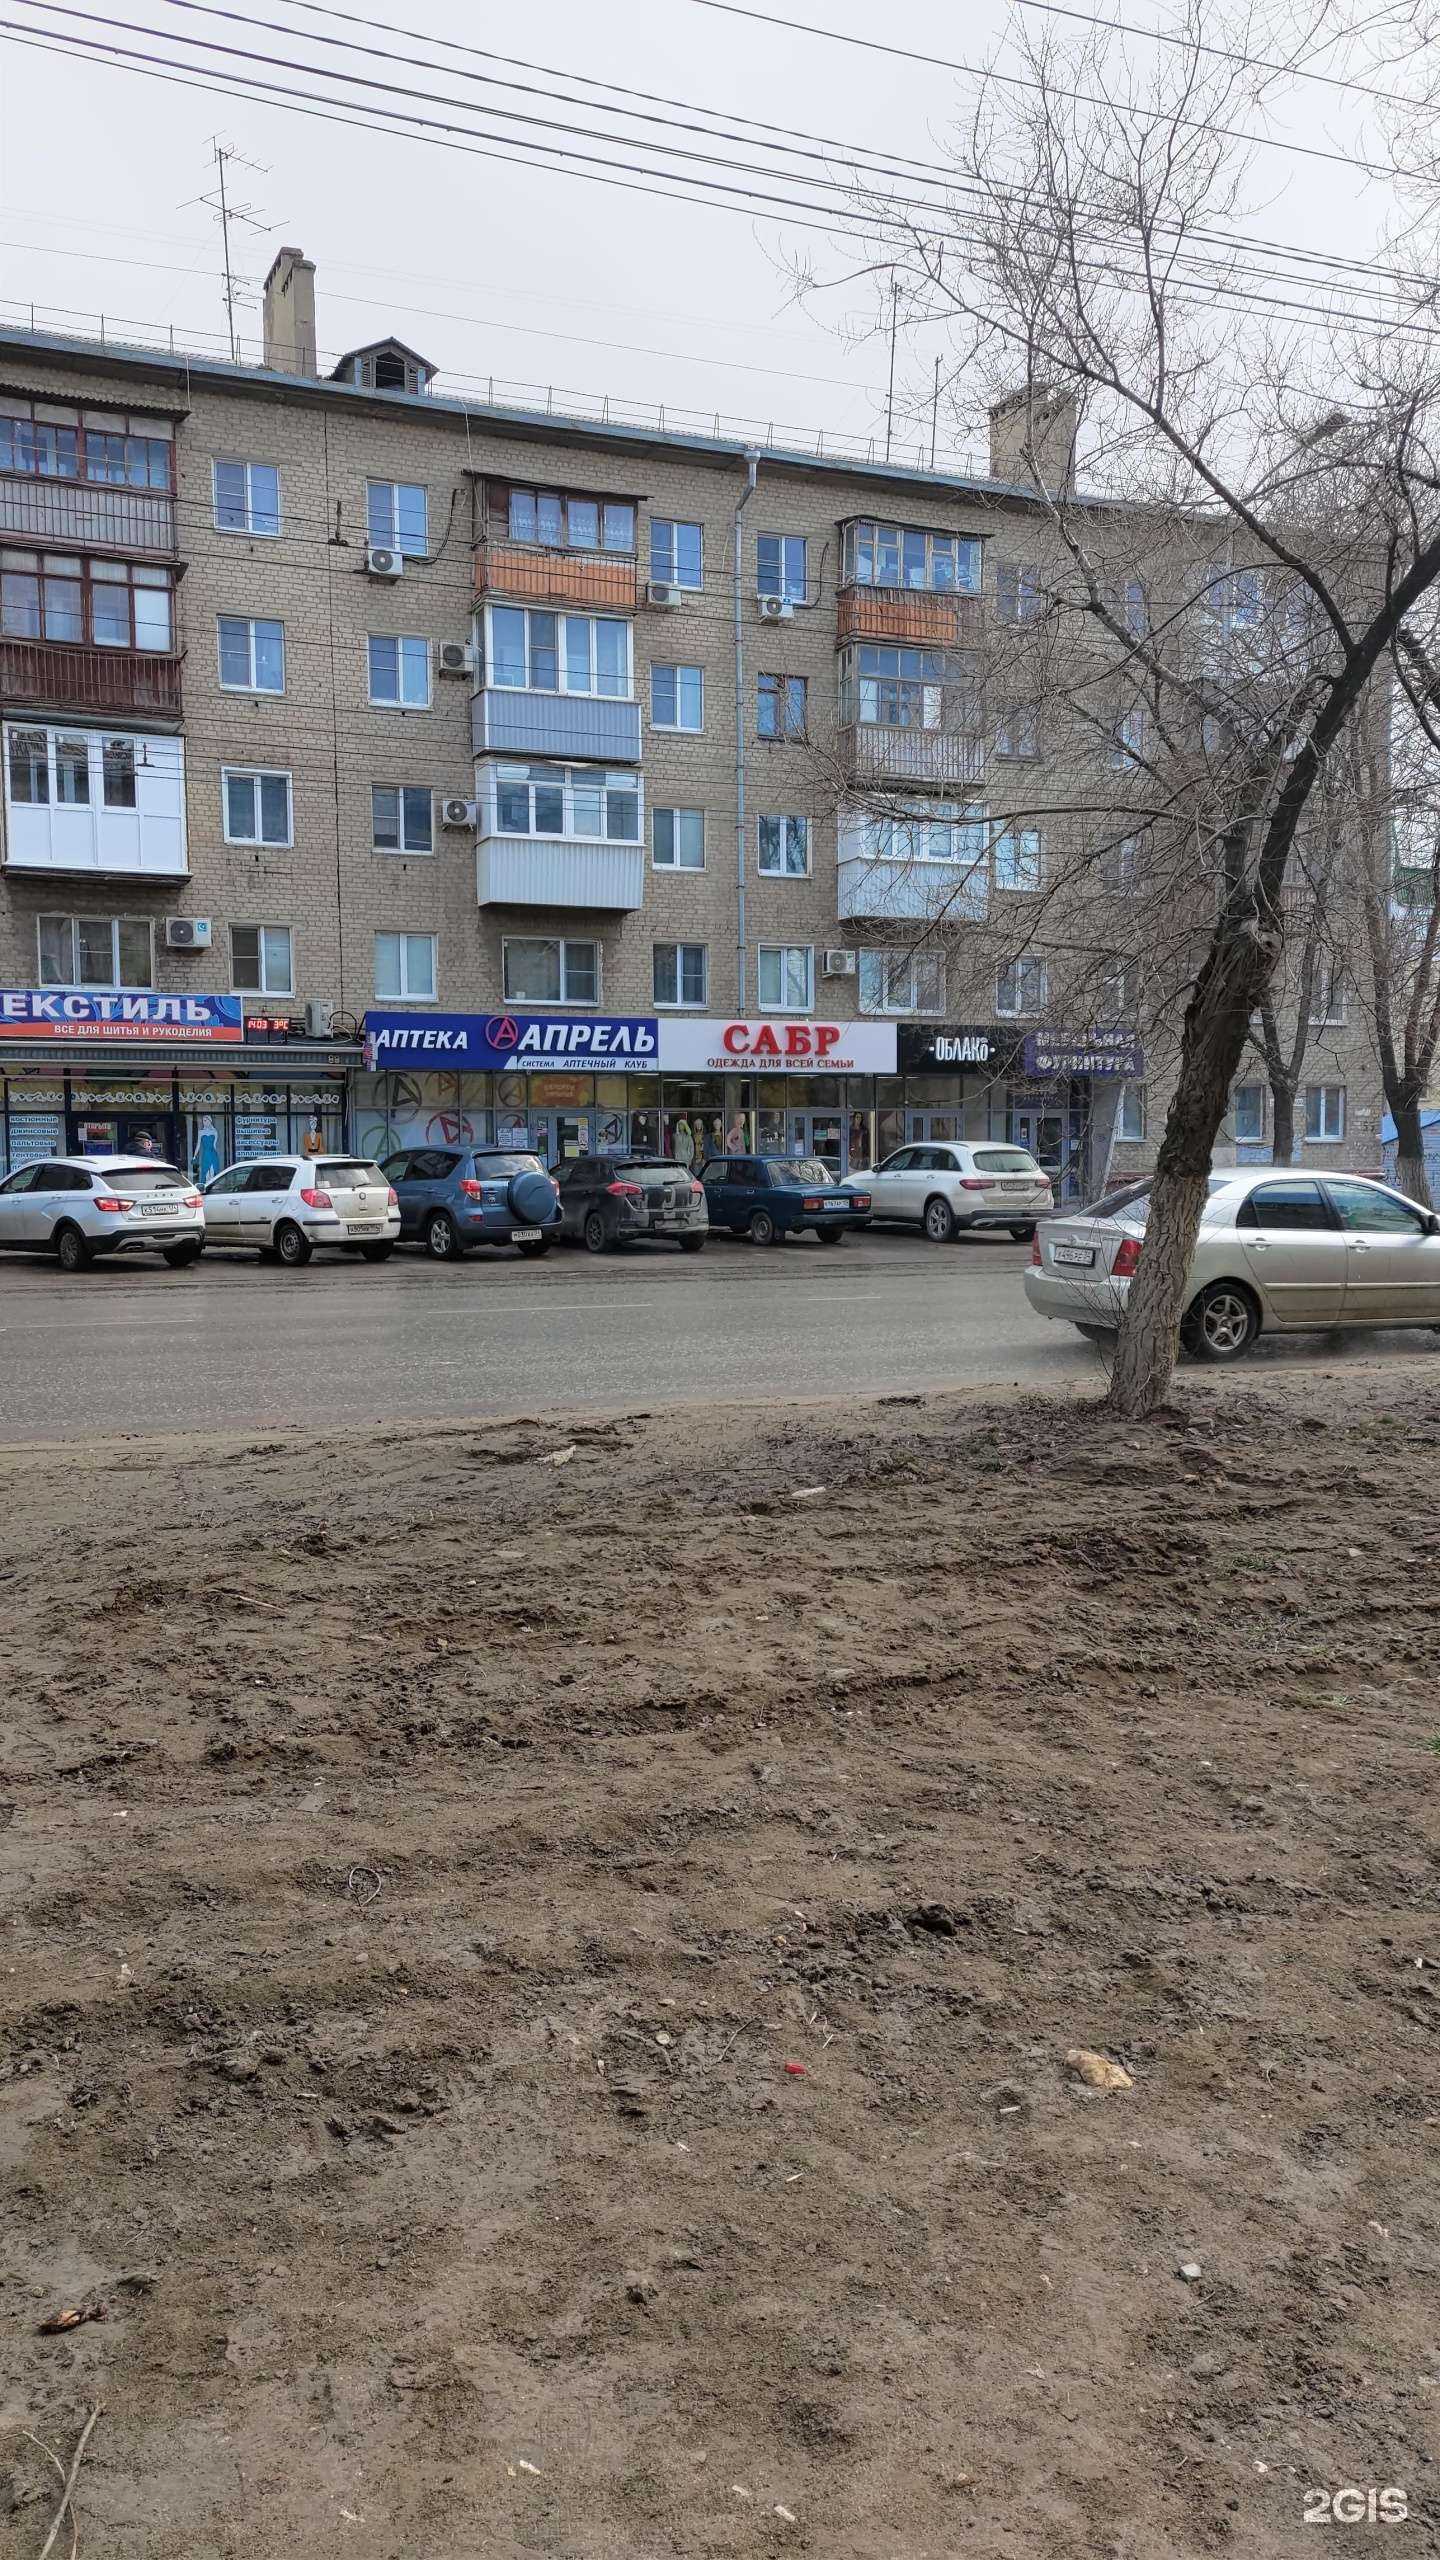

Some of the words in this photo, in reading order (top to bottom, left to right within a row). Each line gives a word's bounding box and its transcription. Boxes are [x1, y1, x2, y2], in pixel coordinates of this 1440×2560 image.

[54, 1024, 75, 1035] ВСЕ
[77, 1025, 99, 1036] ДЛЯ
[103, 1026, 139, 1036] ШИТЬЯ
[142, 1027, 150, 1036] И
[152, 1027, 212, 1038] РУКОДЕЛИЯ
[376, 1029, 469, 1050] АПТЕКА
[518, 1024, 655, 1053] АПРЕЛЬ
[723, 1024, 841, 1057] САБР
[522, 1060, 556, 1069] СИСТЕМА
[562, 1058, 617, 1070] АПТЕЧНЫЙ
[624, 1059, 649, 1070] КЛУБ
[707, 1057, 757, 1070] ОДЕЖДА
[759, 1058, 782, 1069] ДЛЯ
[785, 1056, 814, 1069] ВСЕЙ
[817, 1059, 855, 1070] СЕМЬИ
